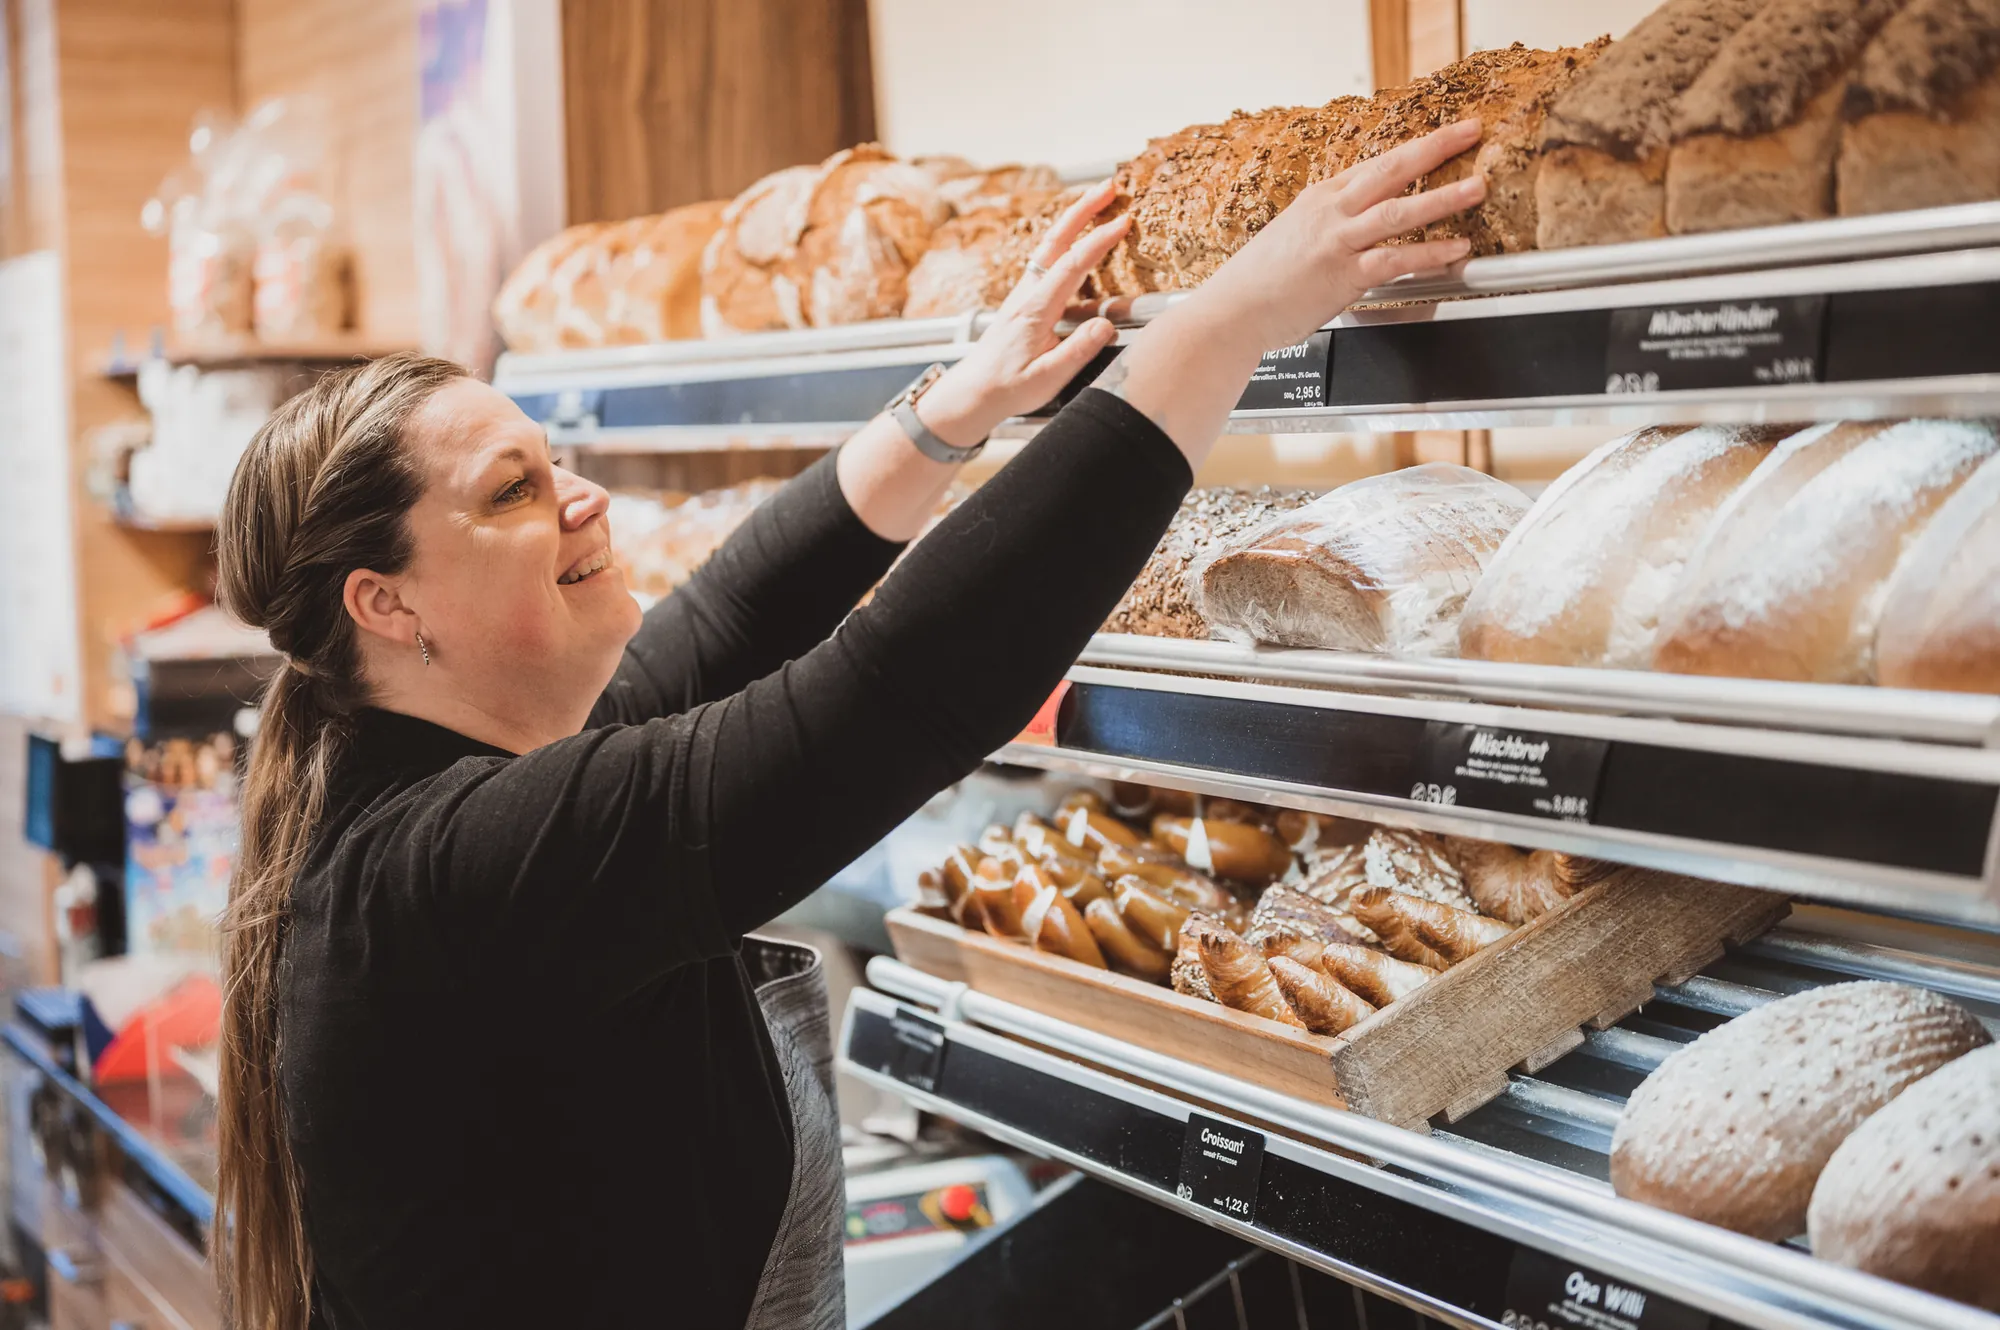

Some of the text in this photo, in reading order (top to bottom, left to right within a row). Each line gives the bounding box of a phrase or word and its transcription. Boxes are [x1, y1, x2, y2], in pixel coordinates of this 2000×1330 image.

[1262, 341, 1309, 360] nerbrot
[1296, 385, 1314, 400] 2,95
[1315, 385, 1321, 398] €
[1469, 732, 1550, 763] Mischbrot
[1201, 1128, 1245, 1154] Croissant
[1225, 1196, 1242, 1212] 1,22
[1242, 1202, 1249, 1215] €
[1565, 1271, 1600, 1305] Opa
[1604, 1283, 1646, 1319] Willi
